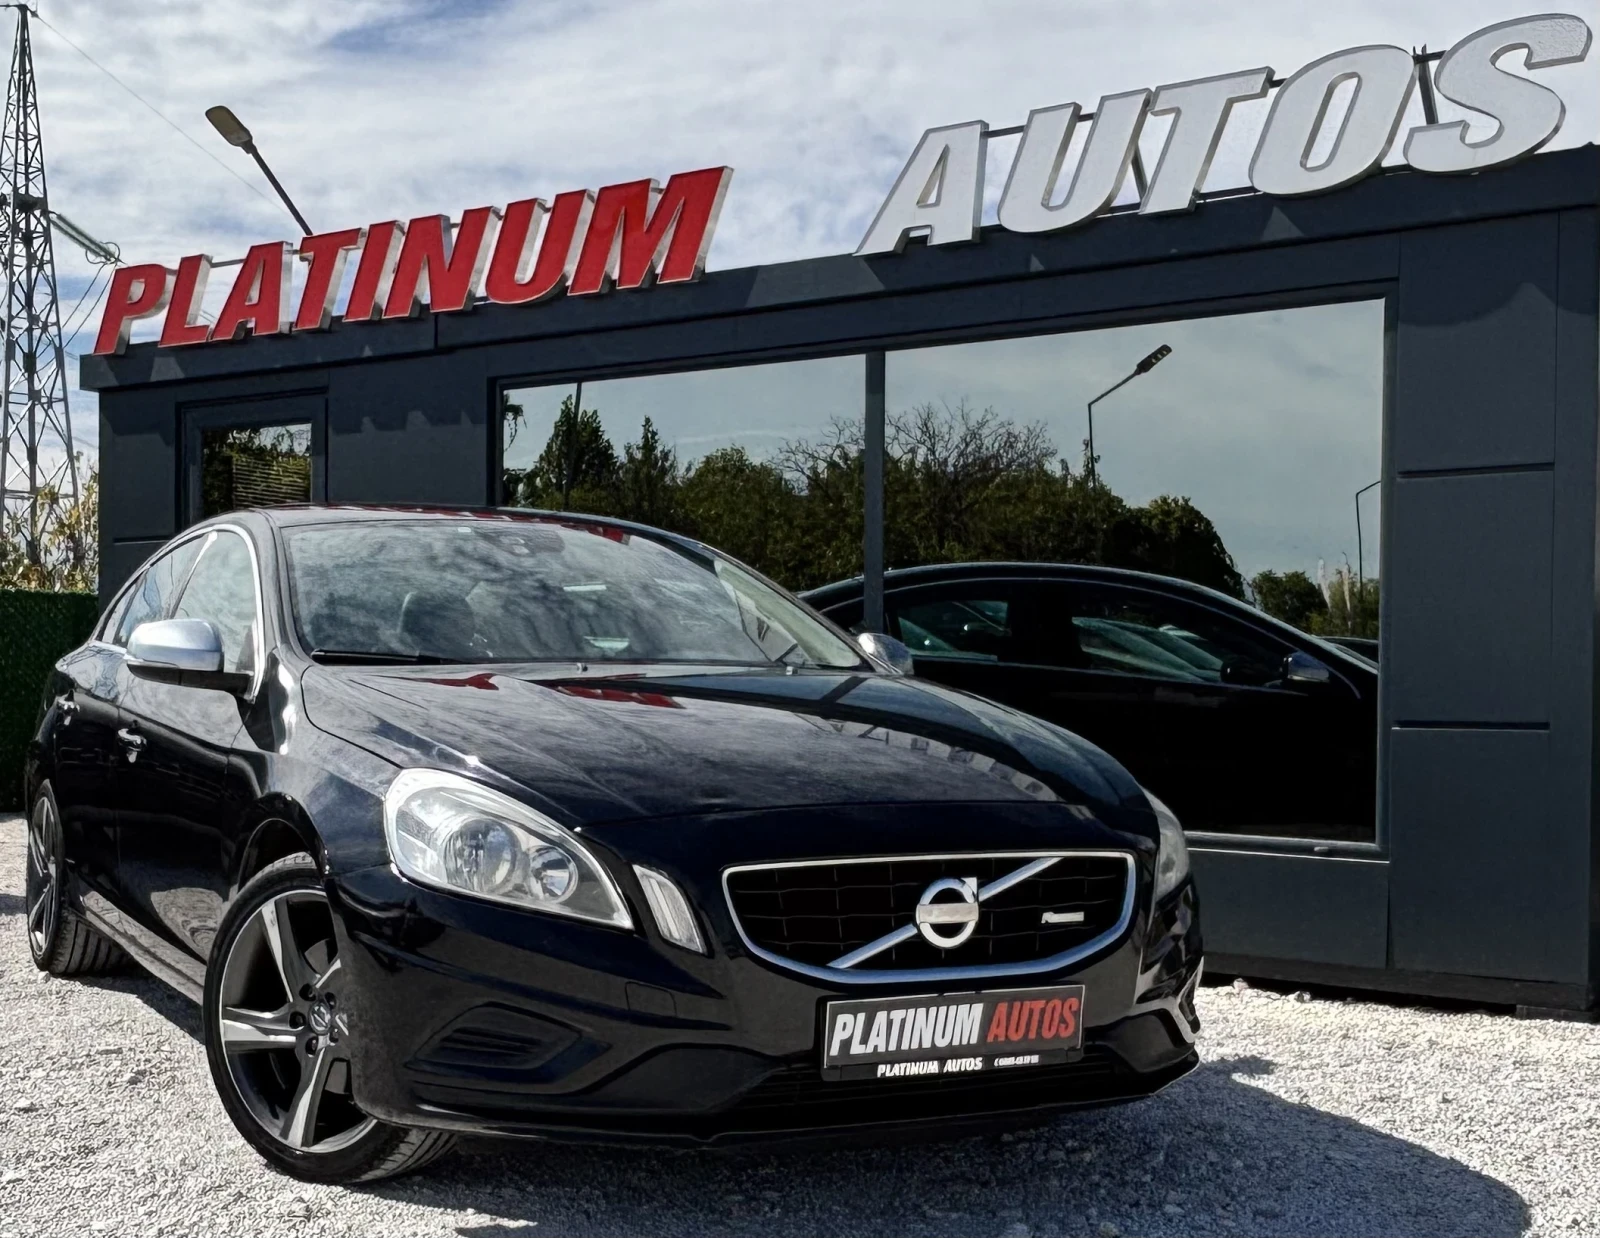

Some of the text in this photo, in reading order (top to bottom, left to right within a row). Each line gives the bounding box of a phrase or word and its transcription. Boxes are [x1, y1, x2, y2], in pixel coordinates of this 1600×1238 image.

[93, 12, 1593, 356] PLATINUM AUTOS
[829, 998, 1079, 1056] PLATINUM AUTOS
[943, 1057, 983, 1073] AUTOS
